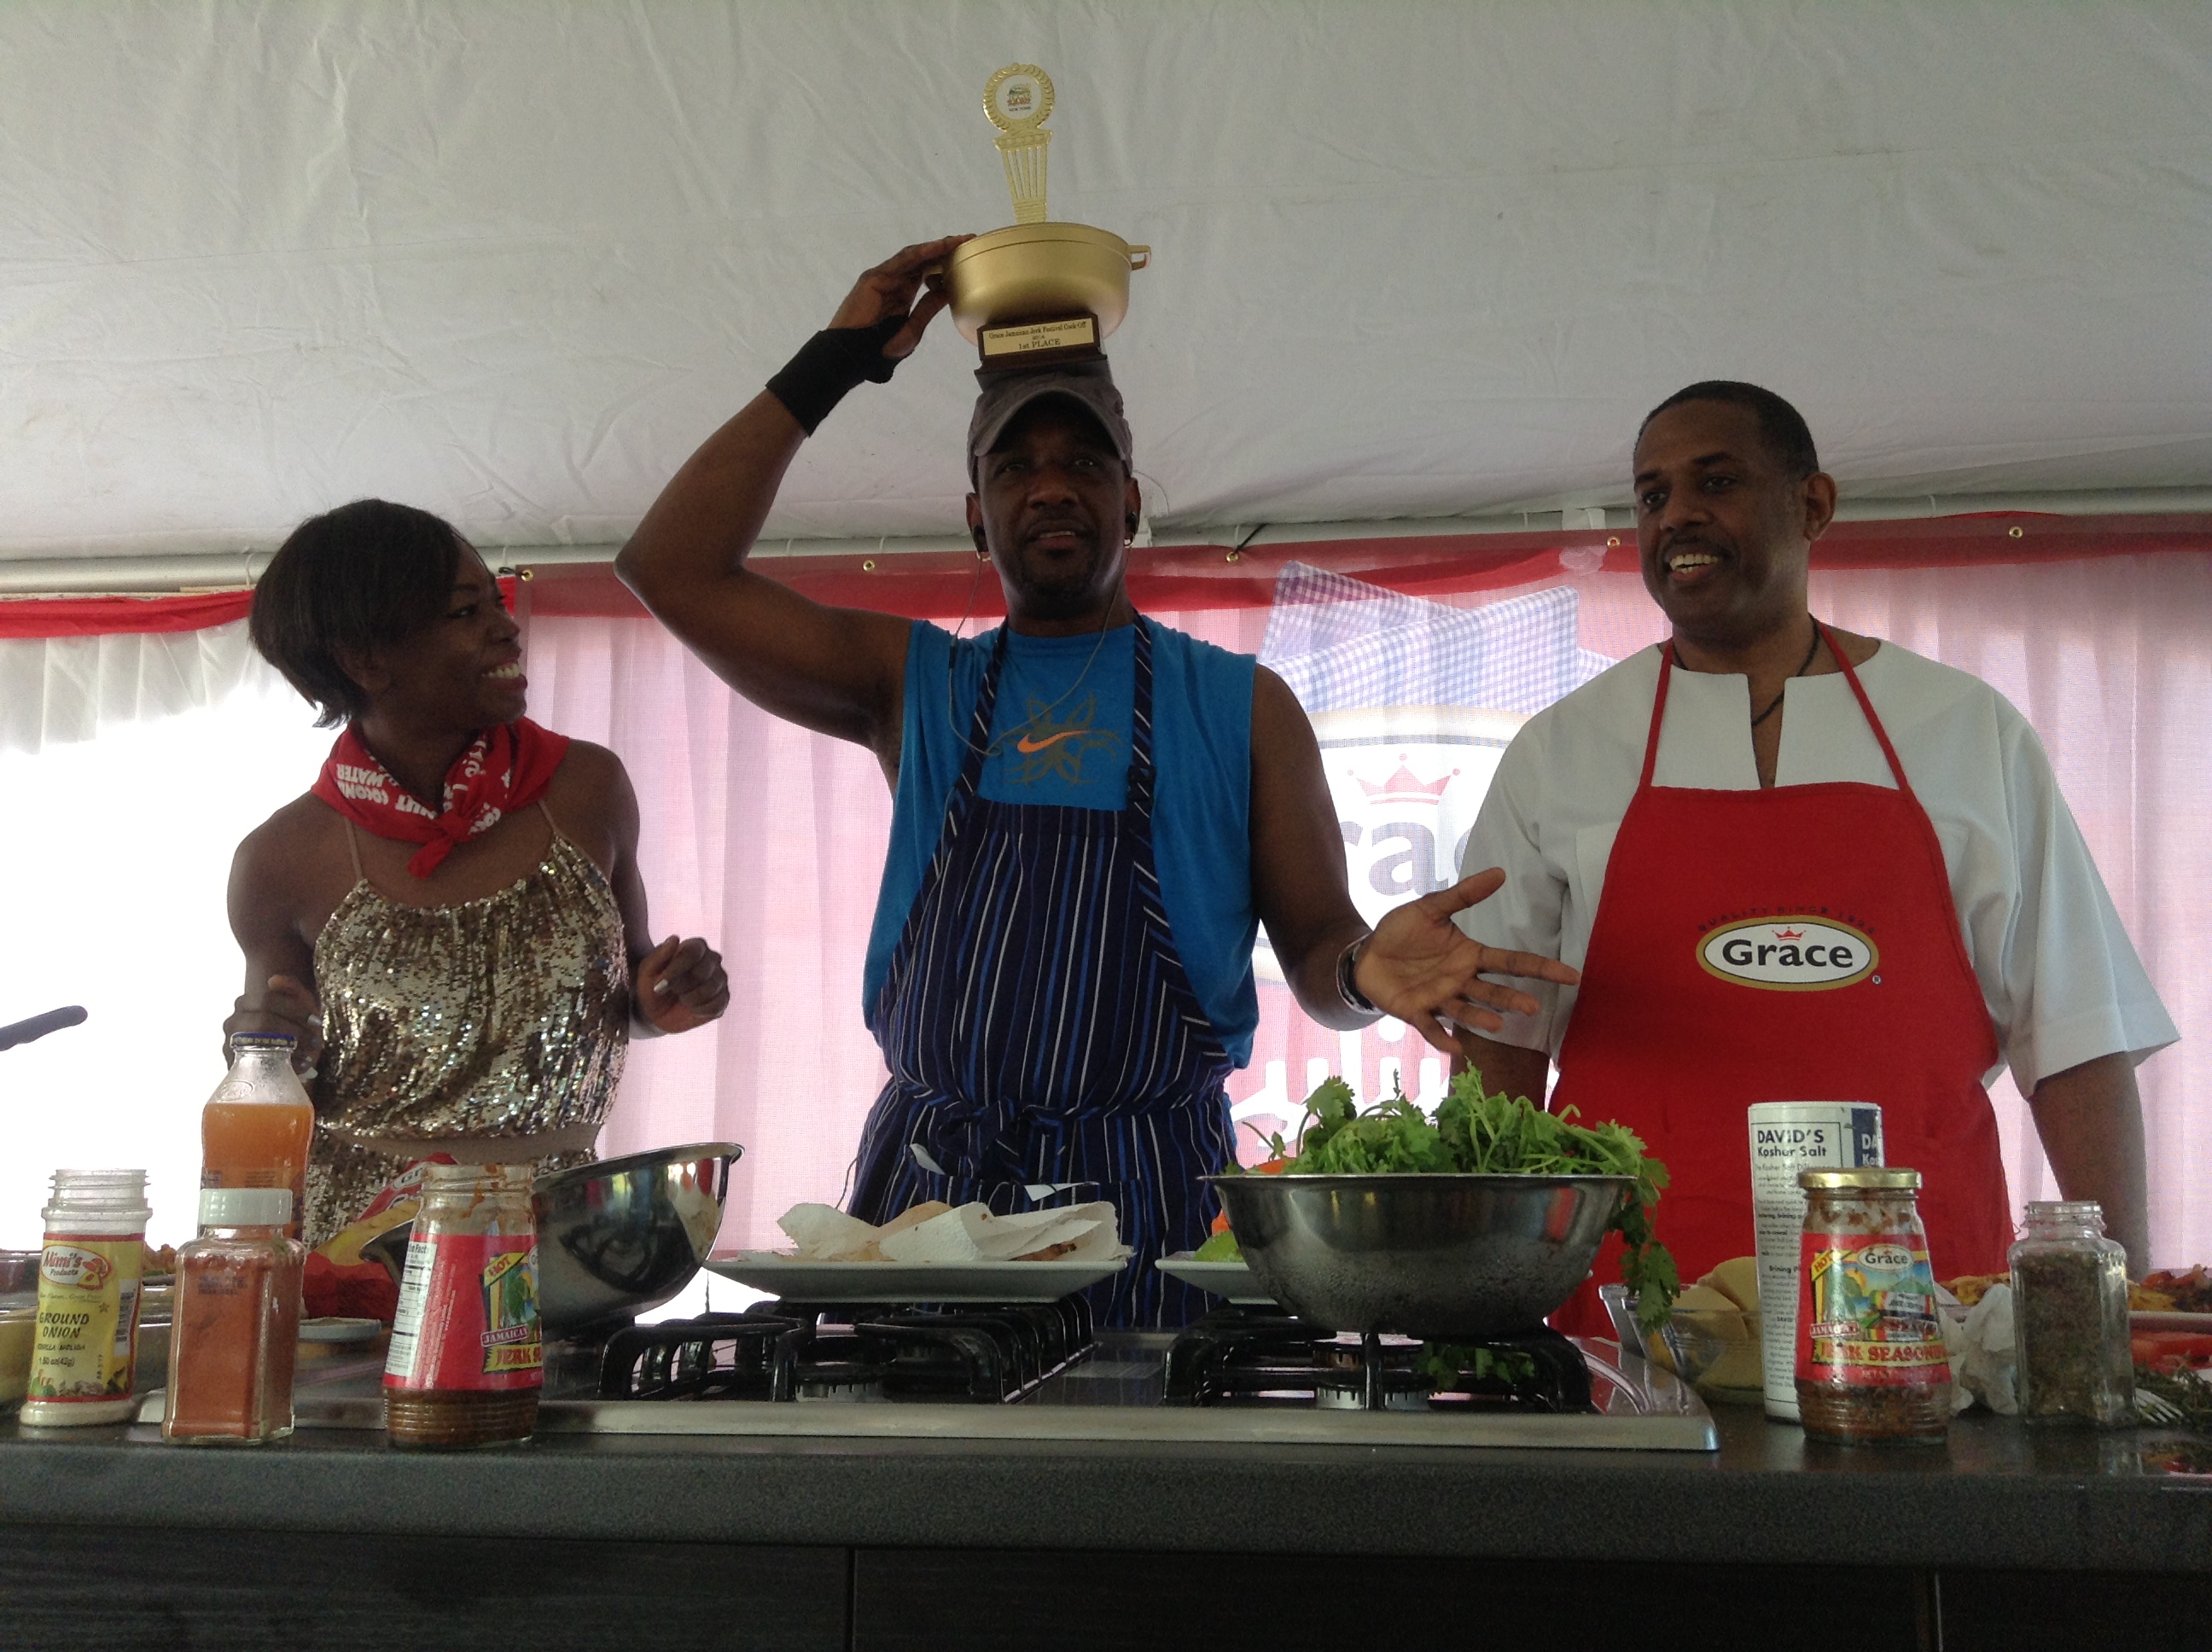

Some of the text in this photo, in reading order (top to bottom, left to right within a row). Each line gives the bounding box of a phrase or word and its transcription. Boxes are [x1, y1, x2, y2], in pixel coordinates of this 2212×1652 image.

[1032, 338, 1061, 349] PLACE
[1722, 939, 1853, 969] Grace
[1757, 1129, 1825, 1144] DAVID'S
[1758, 1146, 1827, 1158] Kosher Salt
[1865, 1253, 1908, 1265] Grace
[487, 1258, 511, 1278] HOT
[39, 1312, 90, 1325] GROUND
[42, 1326, 82, 1339] ONION
[496, 1348, 532, 1364] JERK
